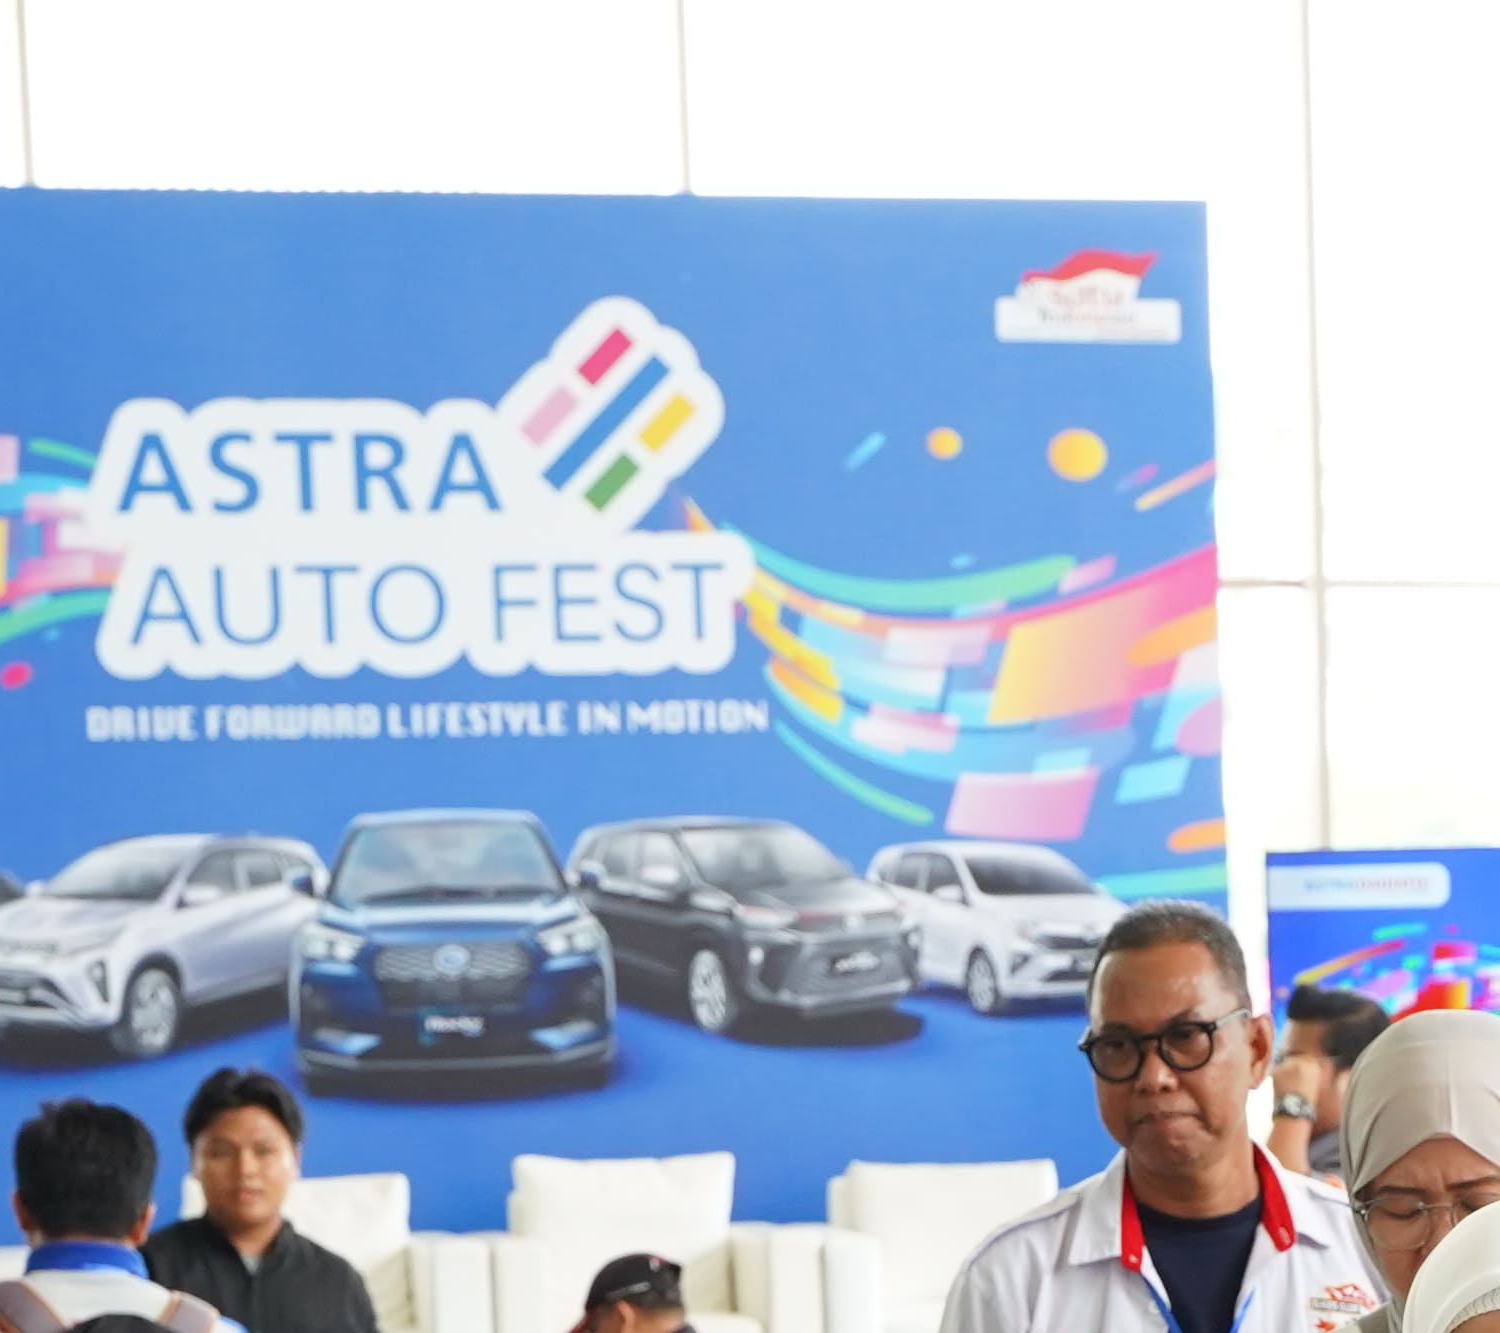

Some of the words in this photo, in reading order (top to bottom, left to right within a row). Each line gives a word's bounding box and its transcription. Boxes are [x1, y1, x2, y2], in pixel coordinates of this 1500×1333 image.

[116, 432, 502, 513] ASTRA
[131, 564, 448, 646] AUTO
[492, 561, 725, 644] FEST
[86, 705, 197, 742] DRIVE
[204, 704, 381, 740] FORWARD
[387, 701, 570, 738] LIFESTYLE
[578, 699, 621, 734] IN
[626, 697, 770, 732] MOTION
